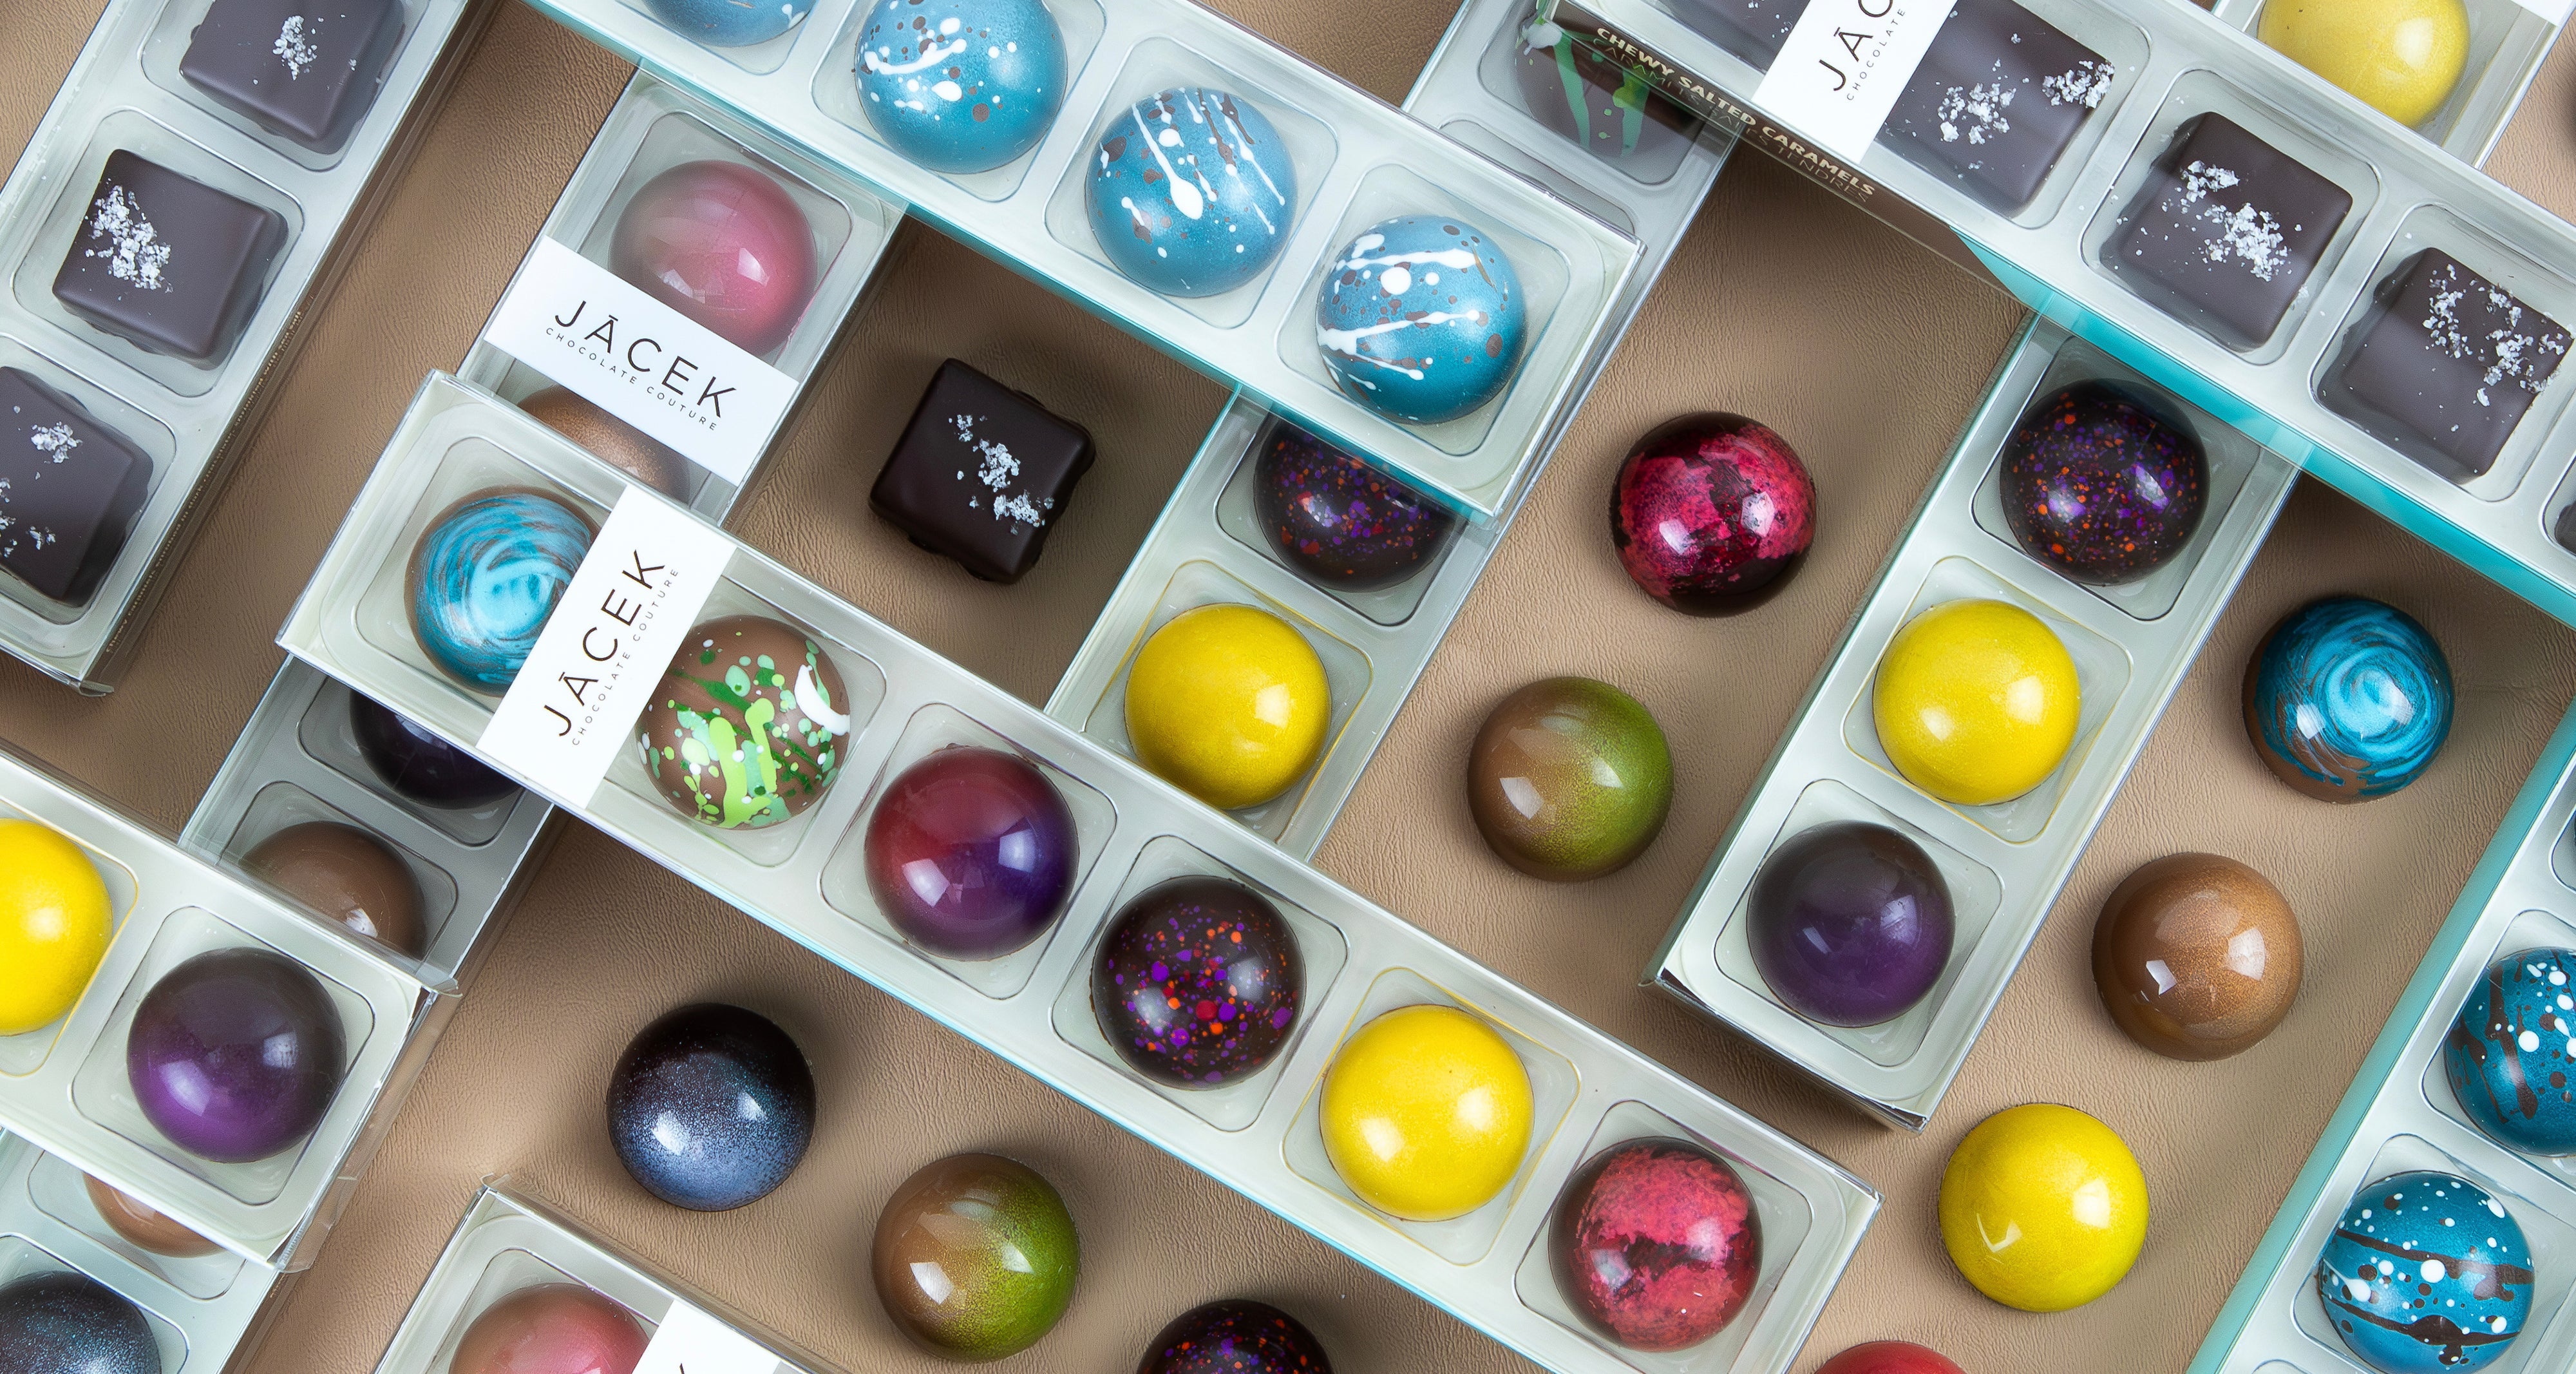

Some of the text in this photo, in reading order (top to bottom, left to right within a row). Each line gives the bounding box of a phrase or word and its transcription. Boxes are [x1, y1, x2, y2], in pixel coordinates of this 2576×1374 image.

[1597, 28, 1875, 195] CHEWY SALTED CARAMELS
[1846, 8, 1906, 100] CHOCOLATE
[546, 327, 717, 430] CHOCOLATE COUTURE
[554, 300, 737, 418] JĀCEK
[544, 549, 665, 737] JĀCEK
[572, 569, 678, 745] CHOCOLATE COUTURE
